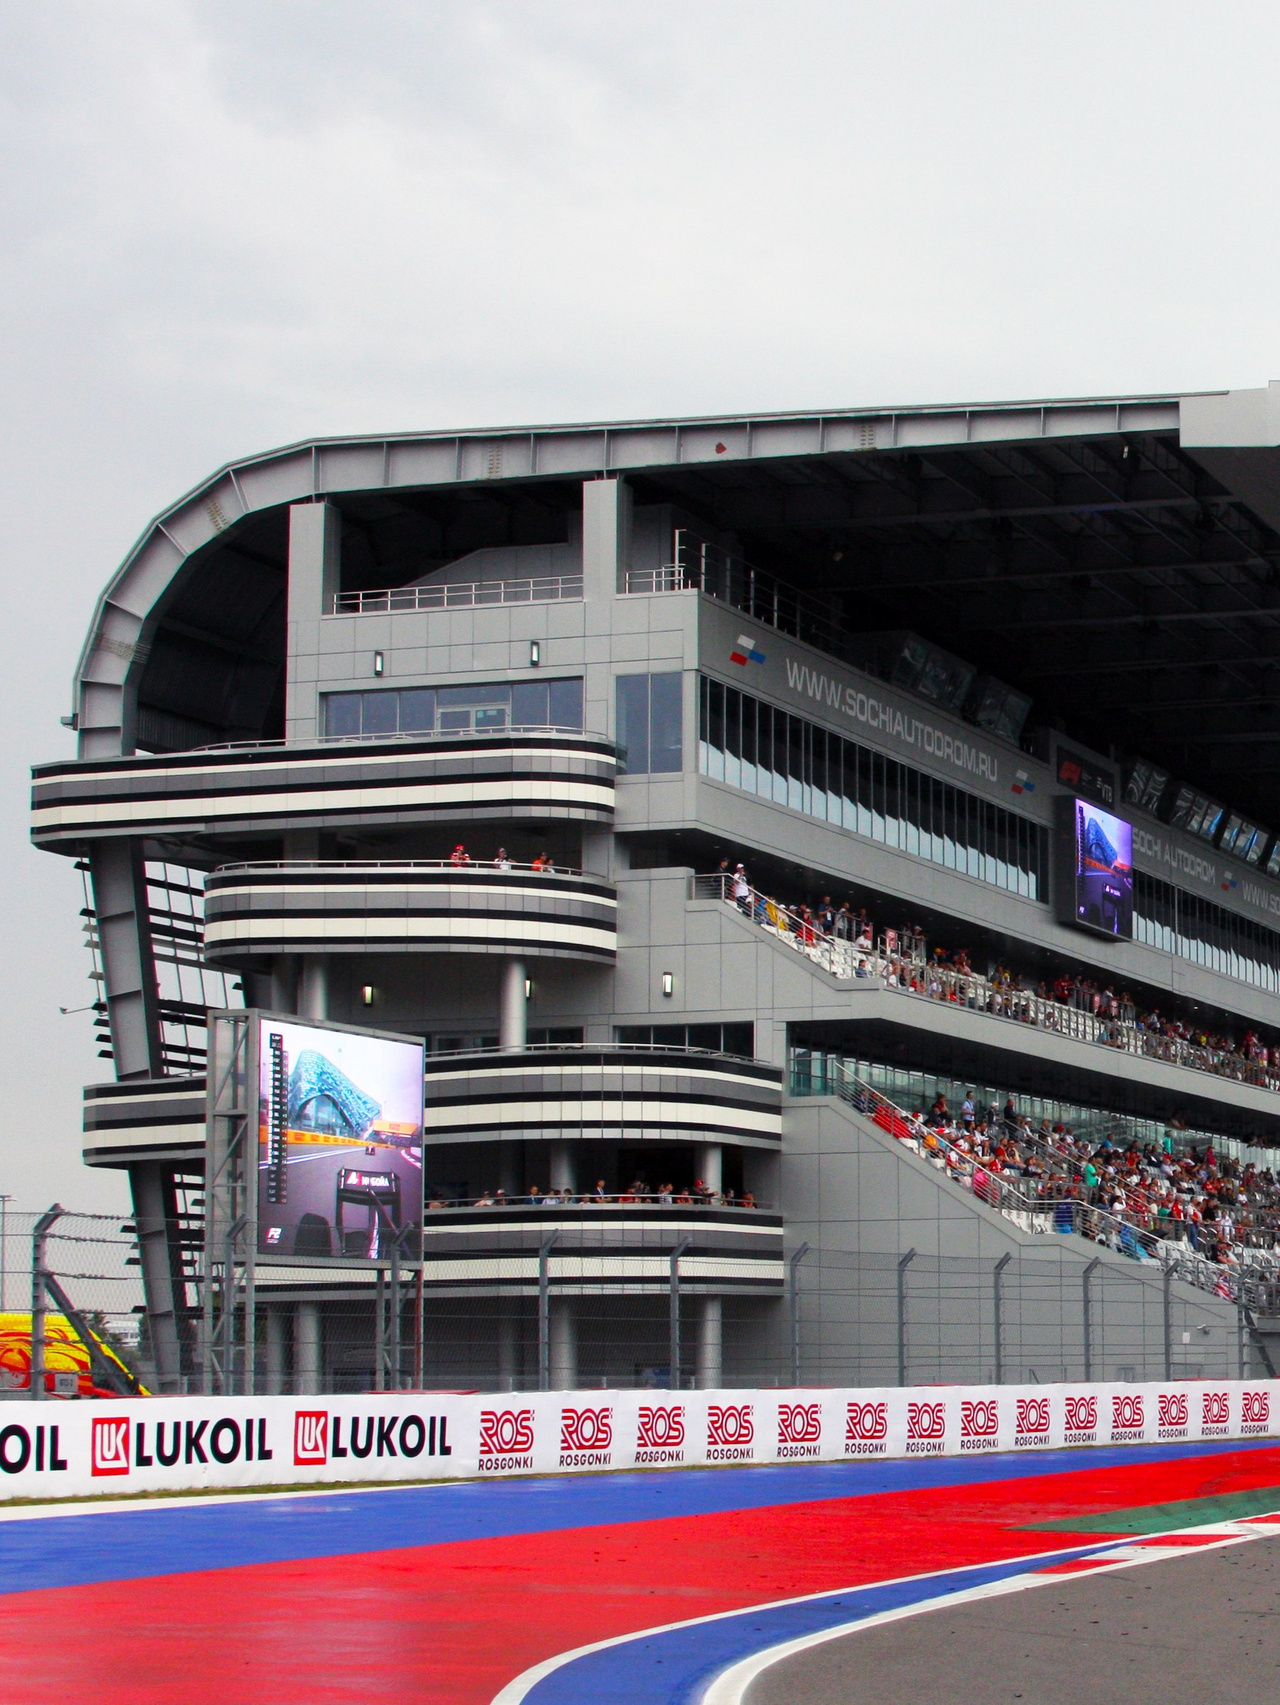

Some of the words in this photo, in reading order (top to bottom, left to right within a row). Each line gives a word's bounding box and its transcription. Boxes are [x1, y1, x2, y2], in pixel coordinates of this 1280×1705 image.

[785, 657, 998, 783] WWW.SOCHIAUTODROM.RU
[1132, 827, 1162, 861] SOCHI
[1164, 843, 1216, 885] AUTODROM
[777, 1402, 823, 1444] ROS
[845, 1402, 889, 1441] ROS
[906, 1401, 946, 1440] ROS
[960, 1400, 999, 1437] ROS
[1015, 1398, 1051, 1434] ROS
[1064, 1396, 1099, 1431] ROS
[1111, 1394, 1146, 1429] ROS
[1157, 1393, 1189, 1427] ROS
[1202, 1391, 1231, 1425] ROS
[1241, 1391, 1271, 1423] ROS
[135, 1417, 273, 1467] LUKOIL
[331, 1414, 452, 1458] LUKOIL
[479, 1409, 535, 1455] ROS
[560, 1407, 613, 1451] ROS
[636, 1405, 686, 1448] ROS
[706, 1405, 755, 1446] ROS
[1015, 1436, 1050, 1446] ROSGONKI
[1064, 1433, 1096, 1443] ROSGONKI
[1111, 1431, 1144, 1441] ROSGONKI
[1158, 1429, 1188, 1438] ROSGONKI
[1201, 1427, 1229, 1435] ROSGONKI
[1241, 1425, 1269, 1434] ROSGONKI
[559, 1453, 611, 1466] ROSGONKI
[634, 1450, 684, 1463] ROSGONKI
[706, 1448, 753, 1460] ROSGONKI
[777, 1446, 820, 1457] ROSGONKI
[845, 1443, 886, 1454] ROSGONKI
[906, 1442, 945, 1453] ROSGONKI
[961, 1439, 998, 1449] ROSGONKI
[478, 1457, 533, 1471] ROSGONKI
